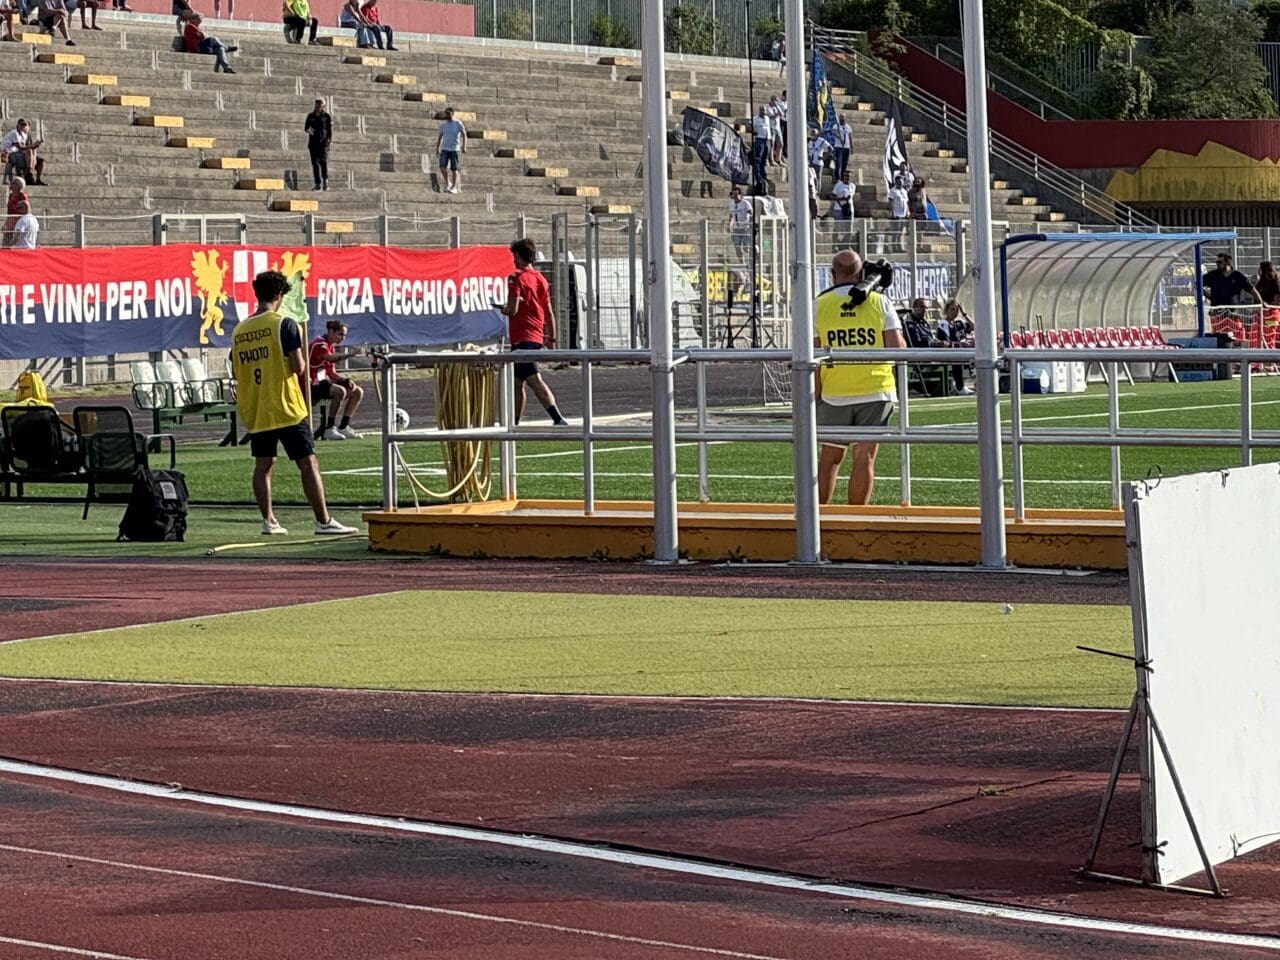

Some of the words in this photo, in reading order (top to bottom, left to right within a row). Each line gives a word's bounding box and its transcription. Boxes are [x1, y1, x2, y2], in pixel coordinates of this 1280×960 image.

[22, 285, 36, 324] E
[40, 283, 101, 324] VINCI
[106, 280, 148, 322] PER
[155, 277, 193, 318] NOI
[317, 277, 376, 316] FORZA
[381, 278, 457, 316] VECCHIO
[827, 328, 876, 347] PRESS
[239, 346, 269, 365] PHOTO
[254, 368, 262, 385] 8
